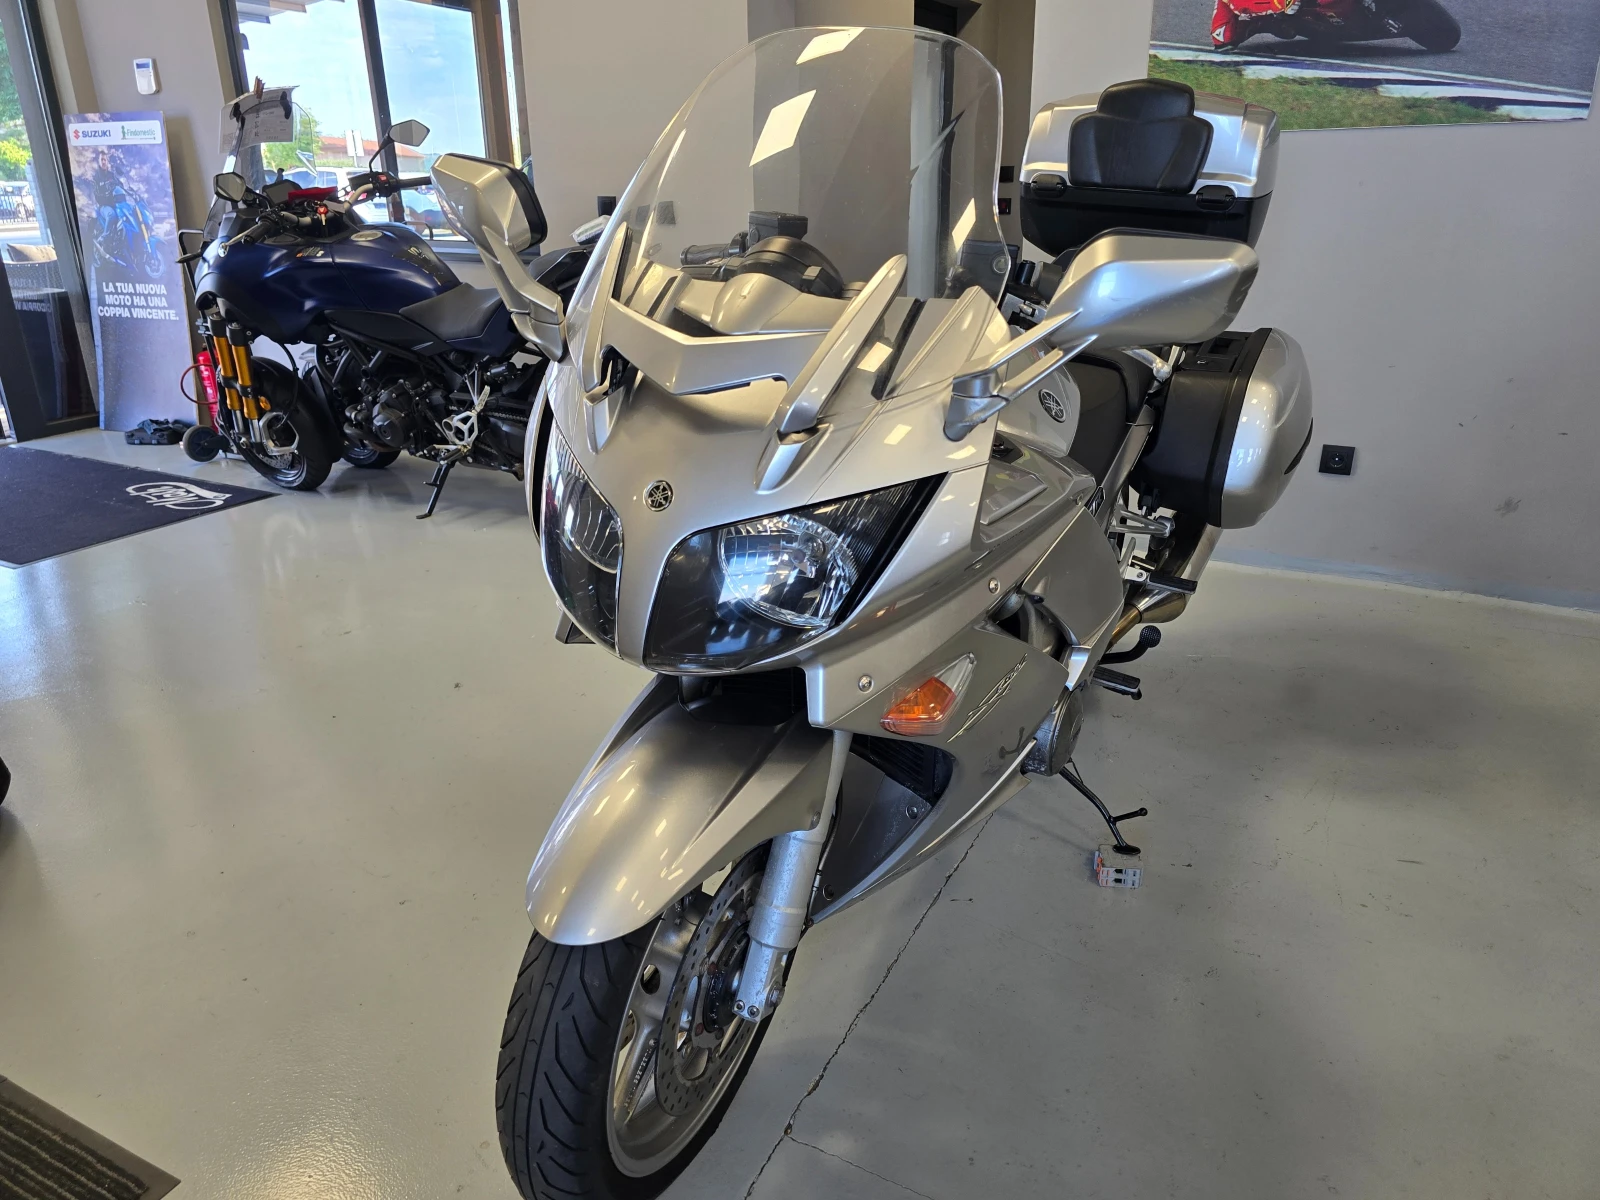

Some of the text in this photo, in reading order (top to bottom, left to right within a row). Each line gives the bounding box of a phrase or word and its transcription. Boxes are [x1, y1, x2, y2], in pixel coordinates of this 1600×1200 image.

[82, 130, 111, 138] SUZUKI
[126, 128, 156, 137] Findomestic
[103, 282, 167, 294] LA TUA NUOVA
[106, 295, 167, 307] MOTO HA UNA
[98, 306, 179, 320] COPPIA VINCENTE.
